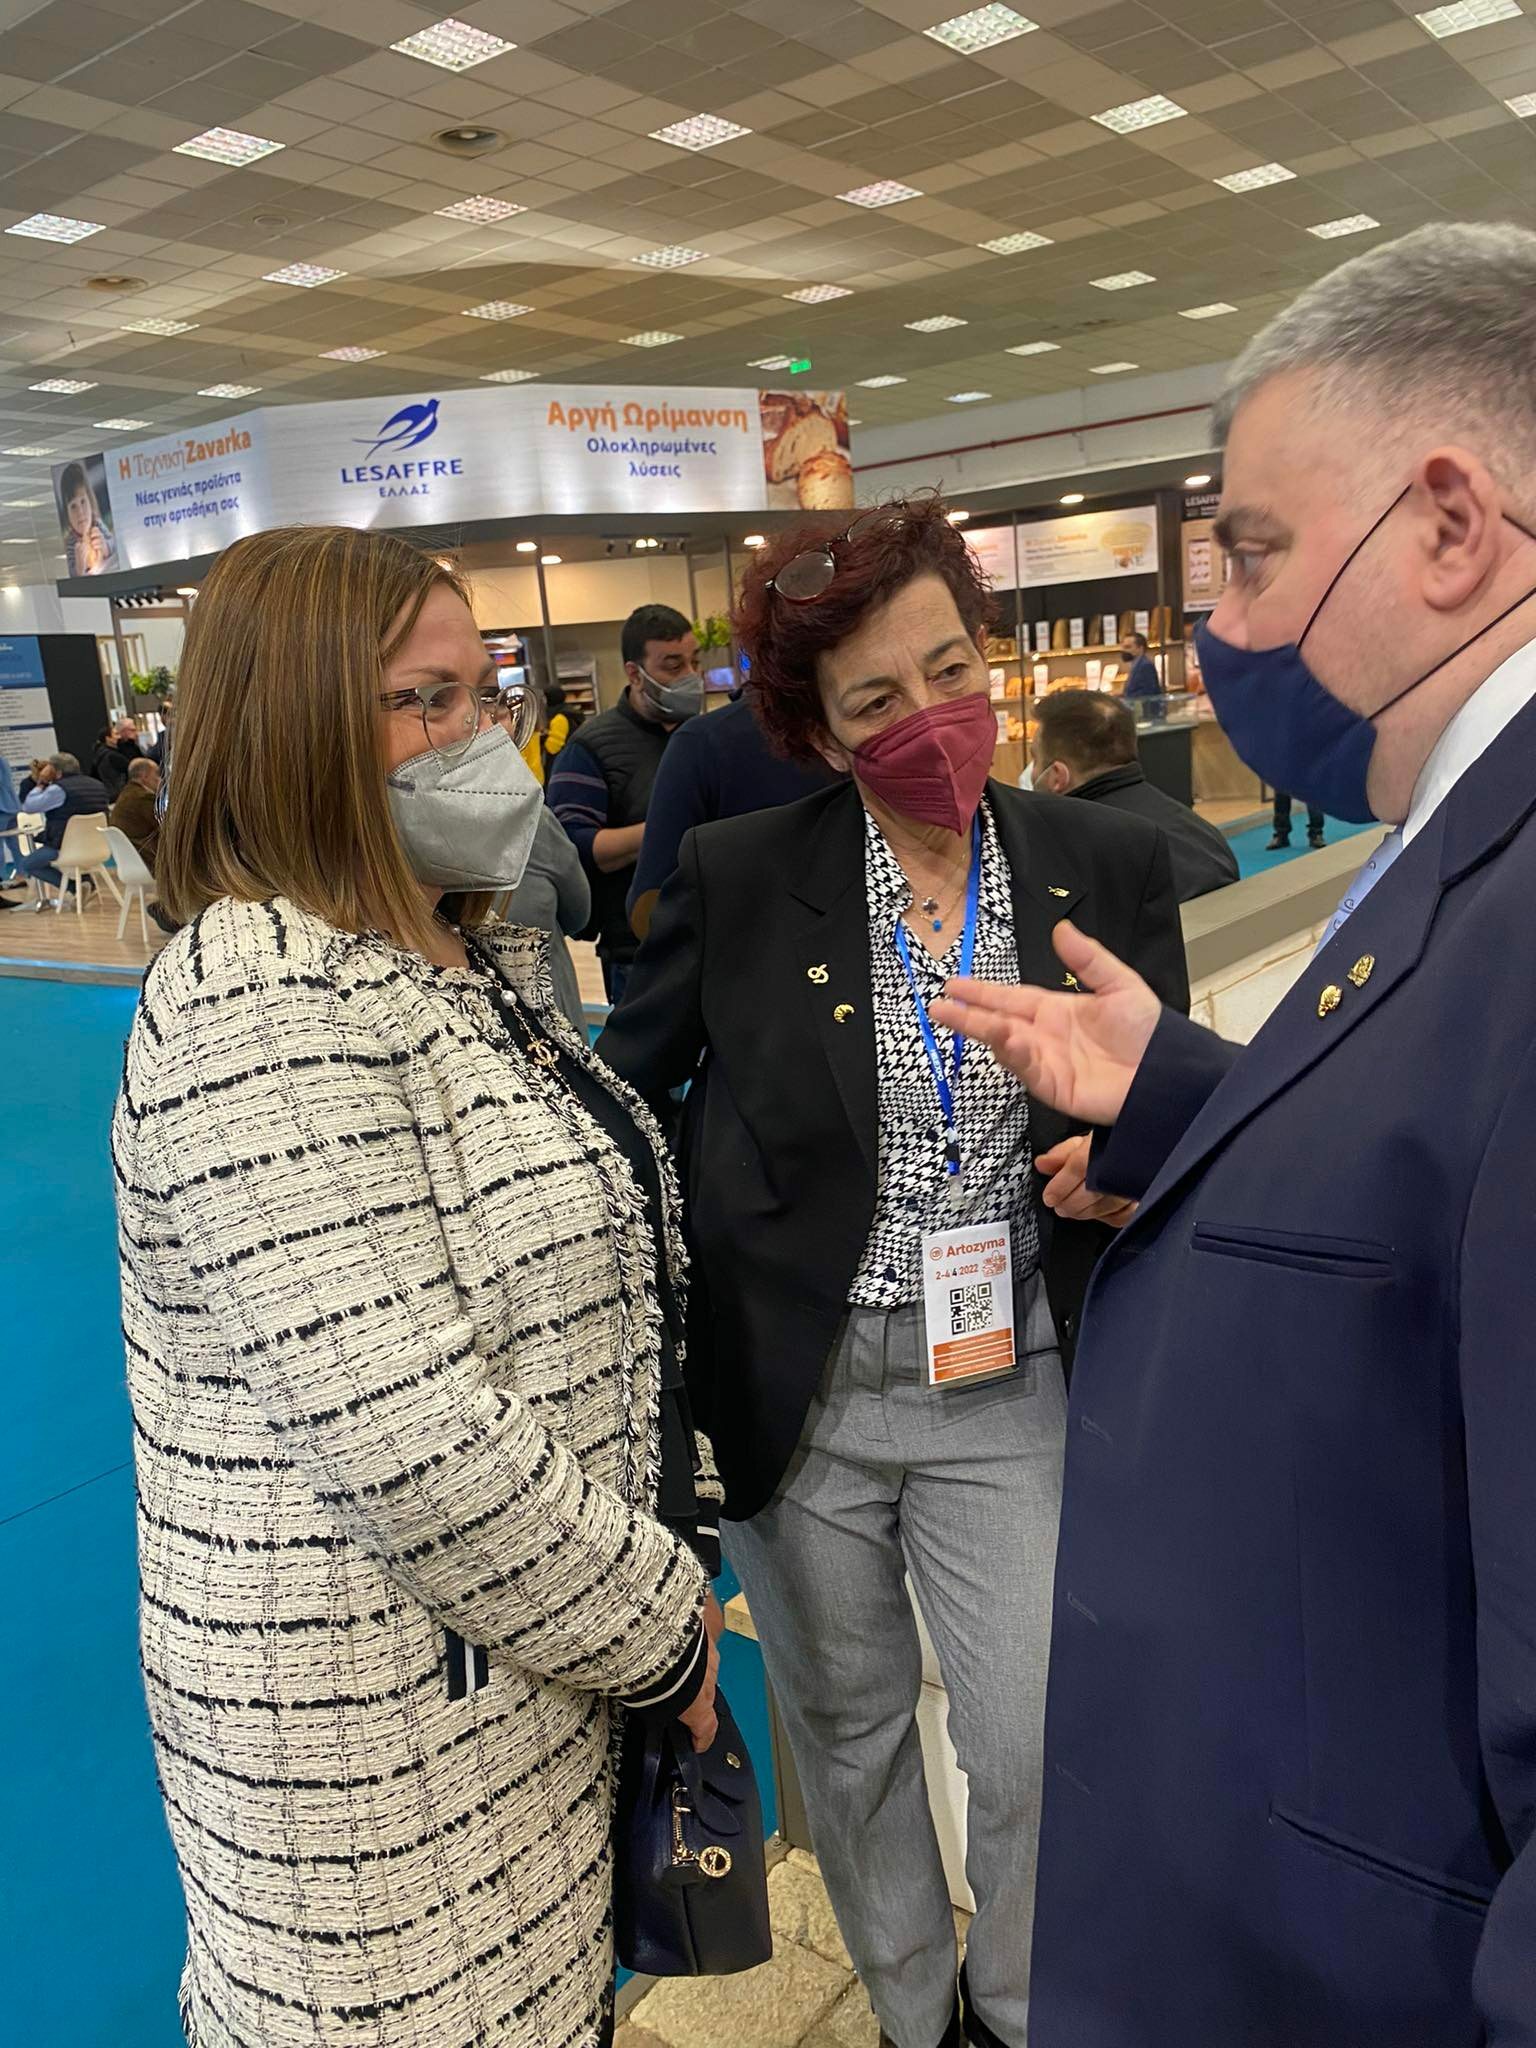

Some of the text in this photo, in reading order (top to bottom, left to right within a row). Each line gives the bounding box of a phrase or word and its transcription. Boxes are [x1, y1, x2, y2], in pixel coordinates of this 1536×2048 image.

[547, 401, 748, 432] Αργή Ωρίμανση
[587, 437, 717, 456] Ολοκληρωμένες
[341, 458, 464, 483] LESAFFRE
[629, 460, 681, 478] λύσεις
[135, 471, 242, 506] Νέας γενιάς προϊόντα
[379, 483, 430, 497] ΕΛΛΑΣ
[143, 497, 239, 527] στην αρτοθήκη σας
[946, 1237, 1006, 1257] Artozyma
[959, 1263, 979, 1275] 2022
